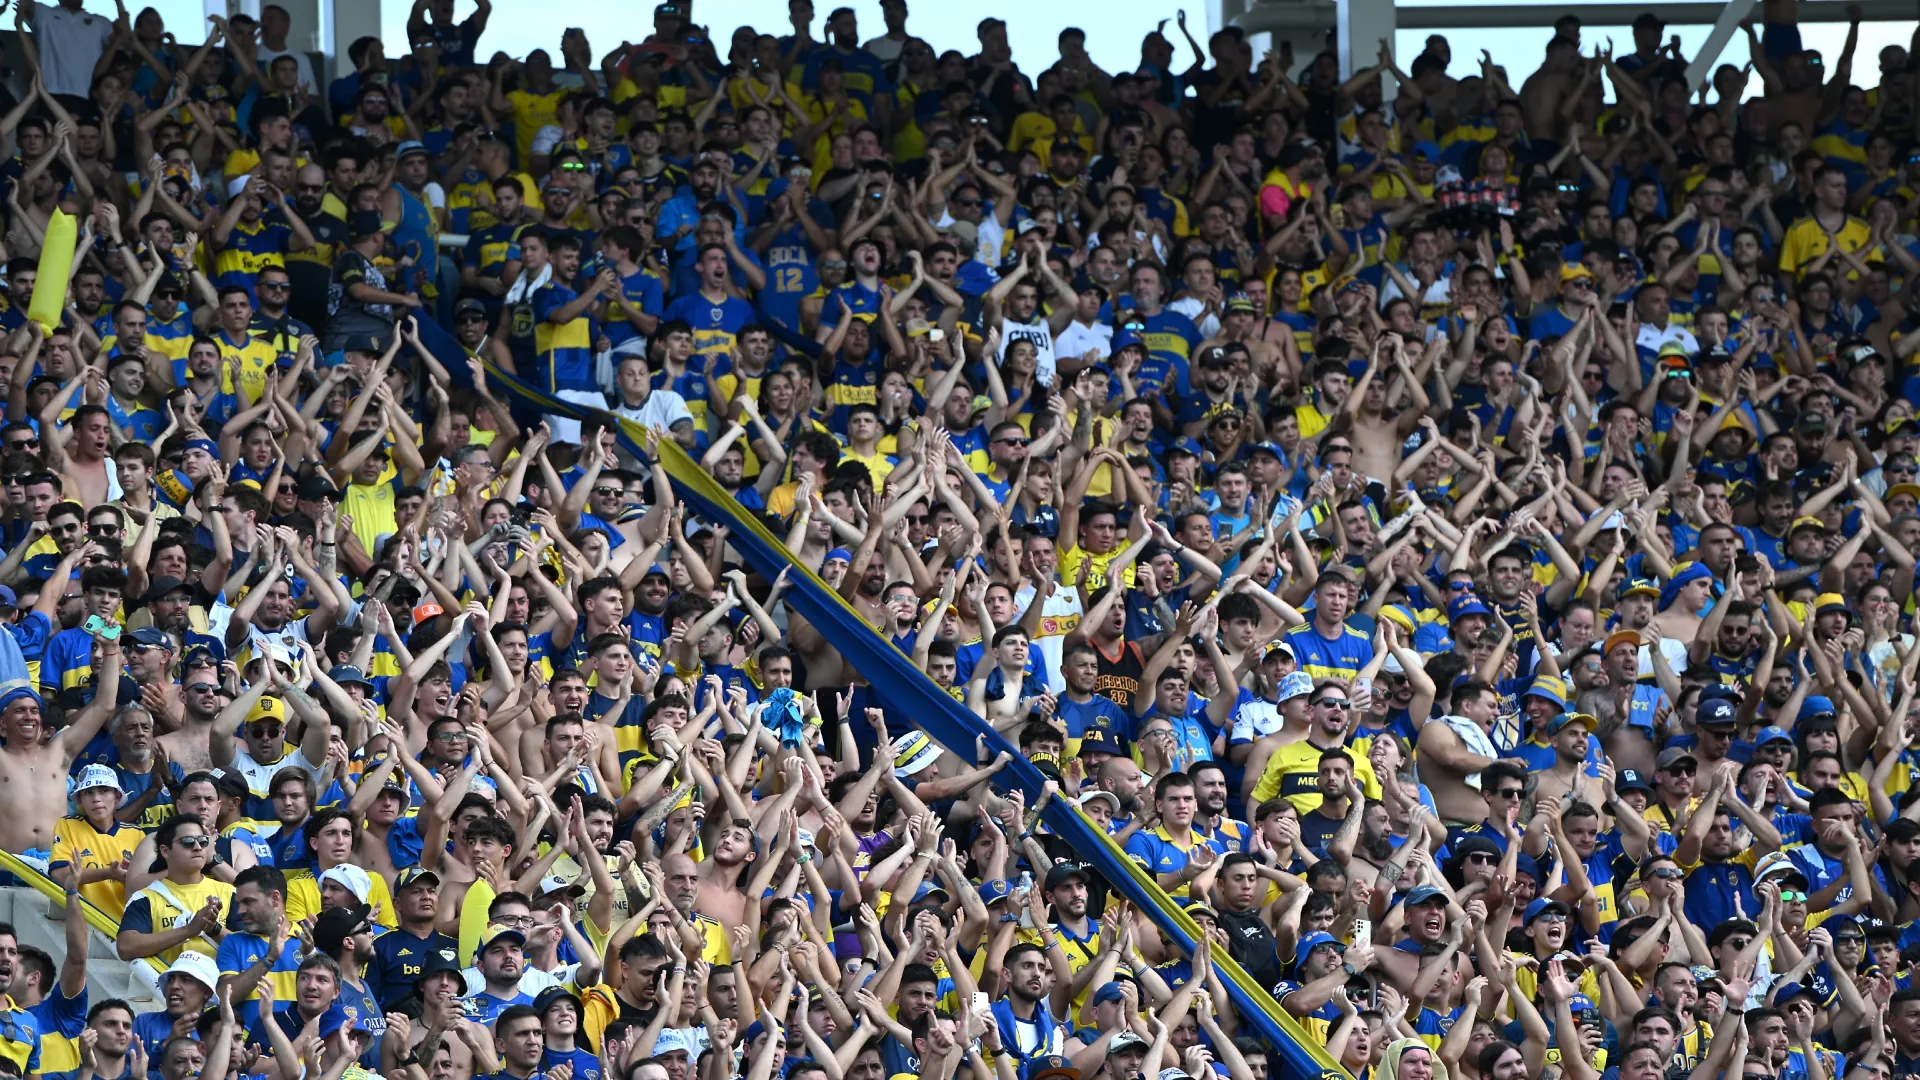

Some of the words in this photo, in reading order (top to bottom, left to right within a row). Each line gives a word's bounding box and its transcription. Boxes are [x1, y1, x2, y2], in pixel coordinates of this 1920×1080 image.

[768, 246, 809, 267] BOCA
[775, 268, 803, 292] 12
[1060, 620, 1076, 630] LG
[1111, 690, 1127, 705] 32
